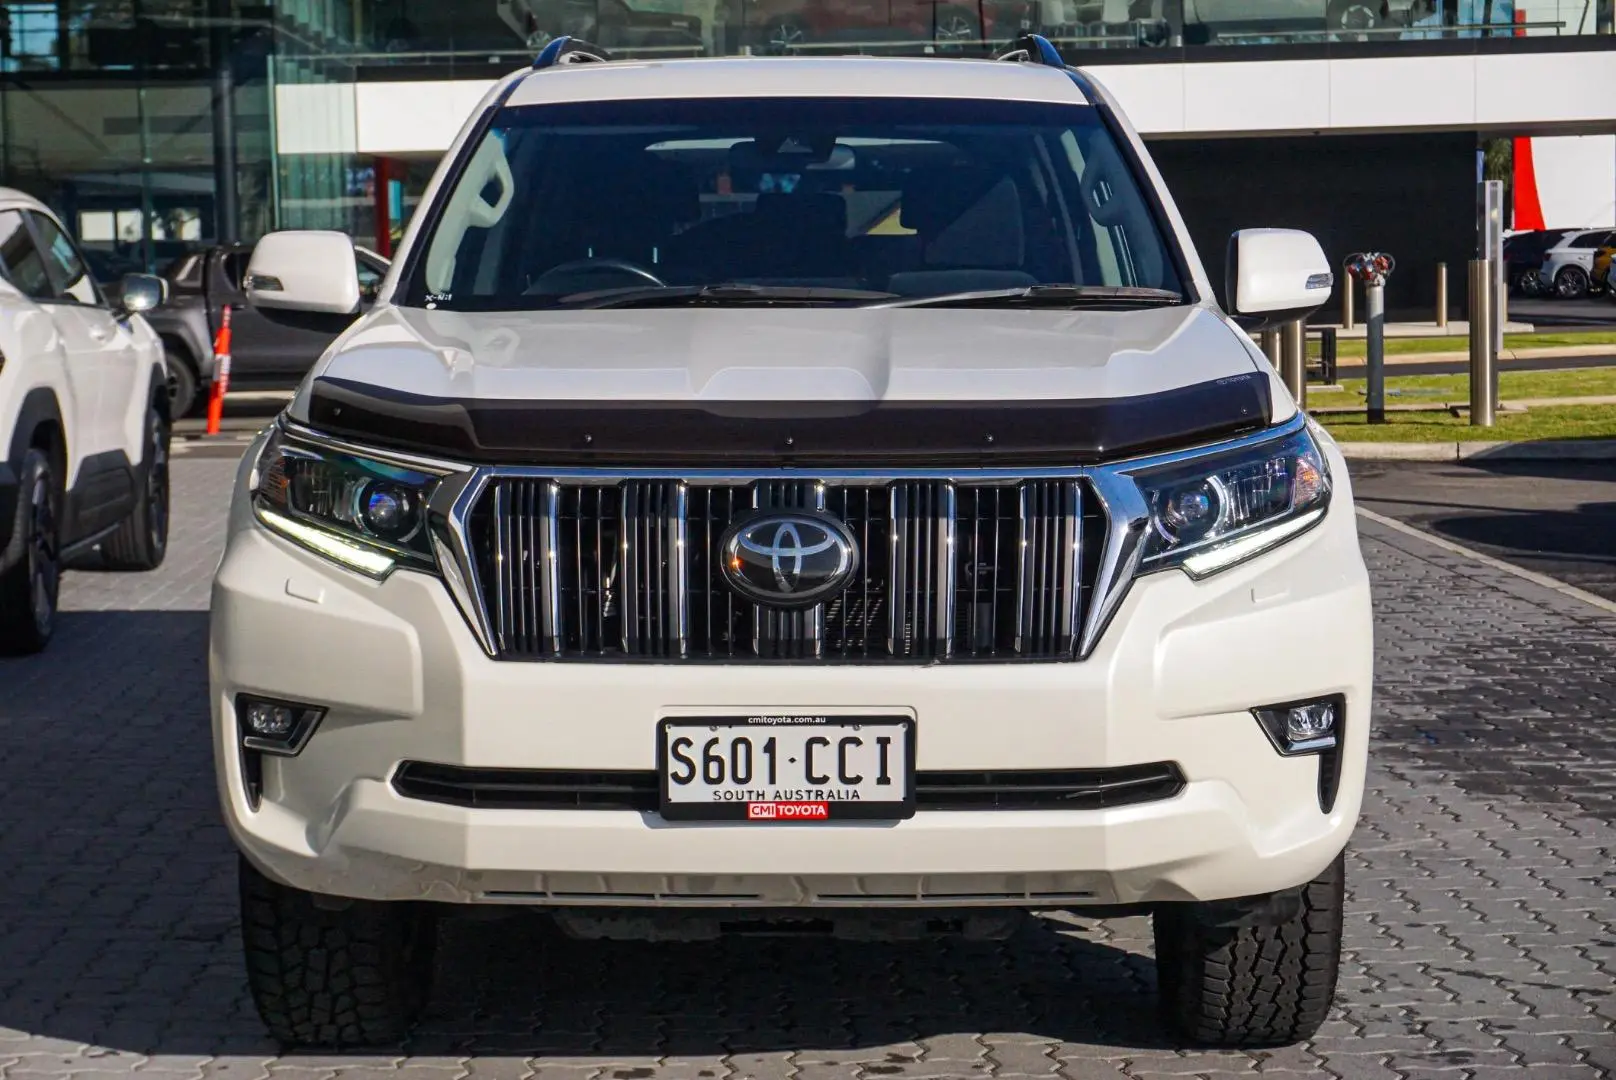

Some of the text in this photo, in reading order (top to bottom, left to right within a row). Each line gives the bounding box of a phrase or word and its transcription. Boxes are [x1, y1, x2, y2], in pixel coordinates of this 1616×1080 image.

[748, 715, 826, 725] cmitoyota.com.au
[713, 789, 861, 800] SOUTH AUSTRALIA
[751, 805, 826, 816] CMI TOYOTA
